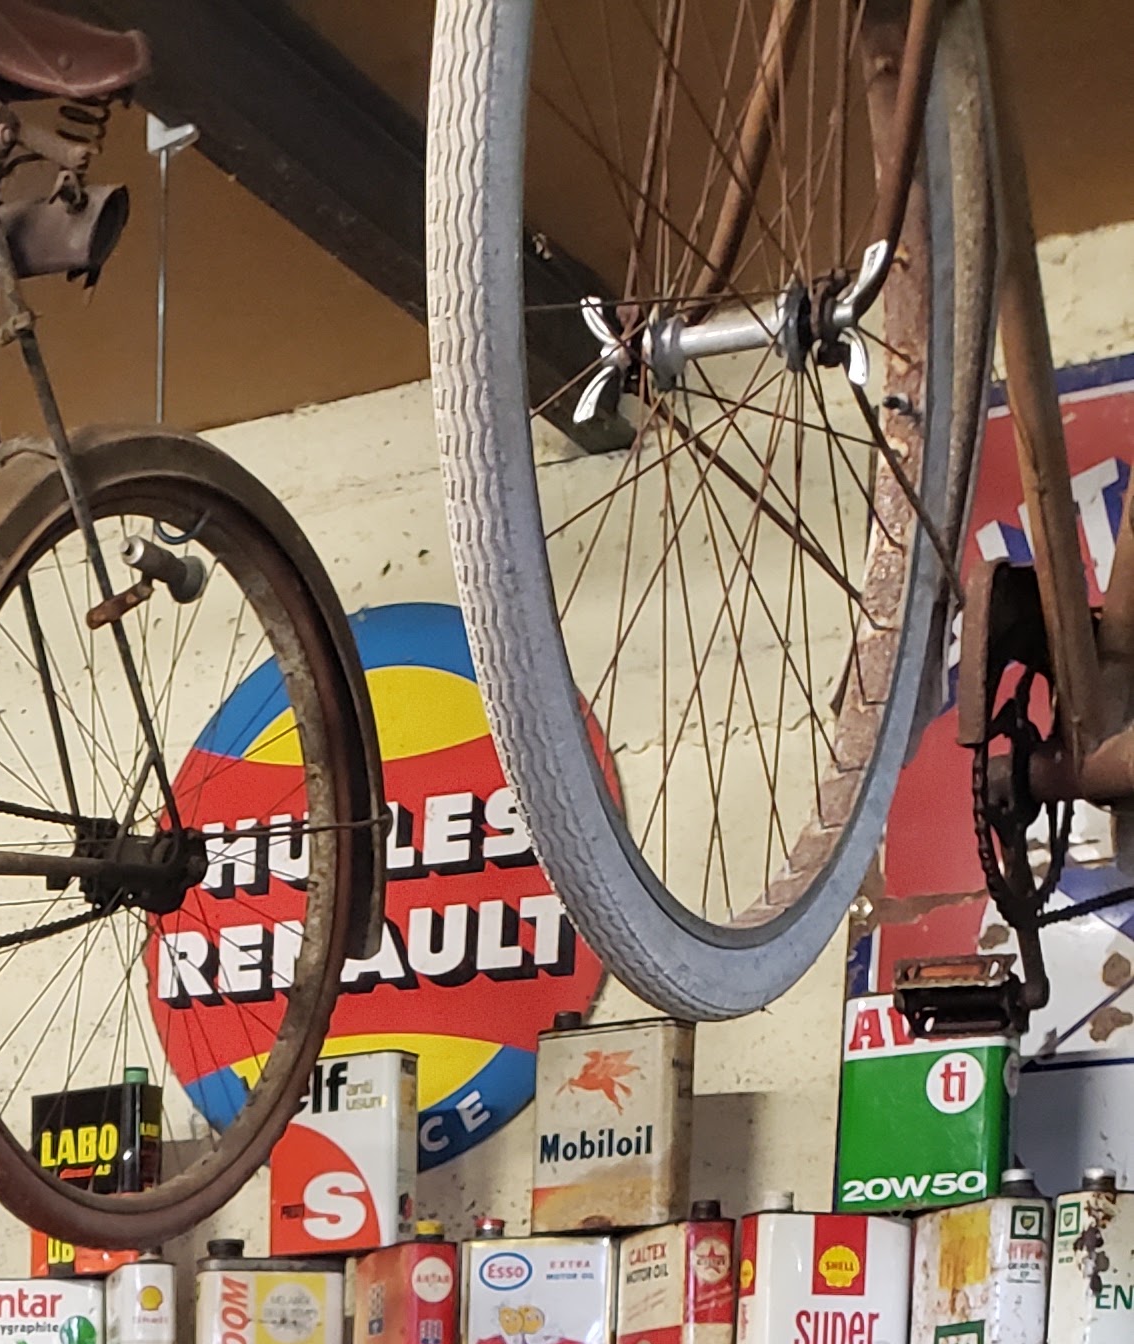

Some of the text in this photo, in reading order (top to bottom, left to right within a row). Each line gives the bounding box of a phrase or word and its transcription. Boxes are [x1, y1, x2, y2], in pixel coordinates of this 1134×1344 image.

[299, 1061, 348, 1114] lf
[40, 1123, 118, 1168] LABO
[539, 1125, 653, 1164] Mobiloil
[841, 1170, 987, 1202] 20W50
[303, 1171, 367, 1241] S
[629, 1243, 668, 1266] CALTEX
[825, 1261, 855, 1272] SHELL
